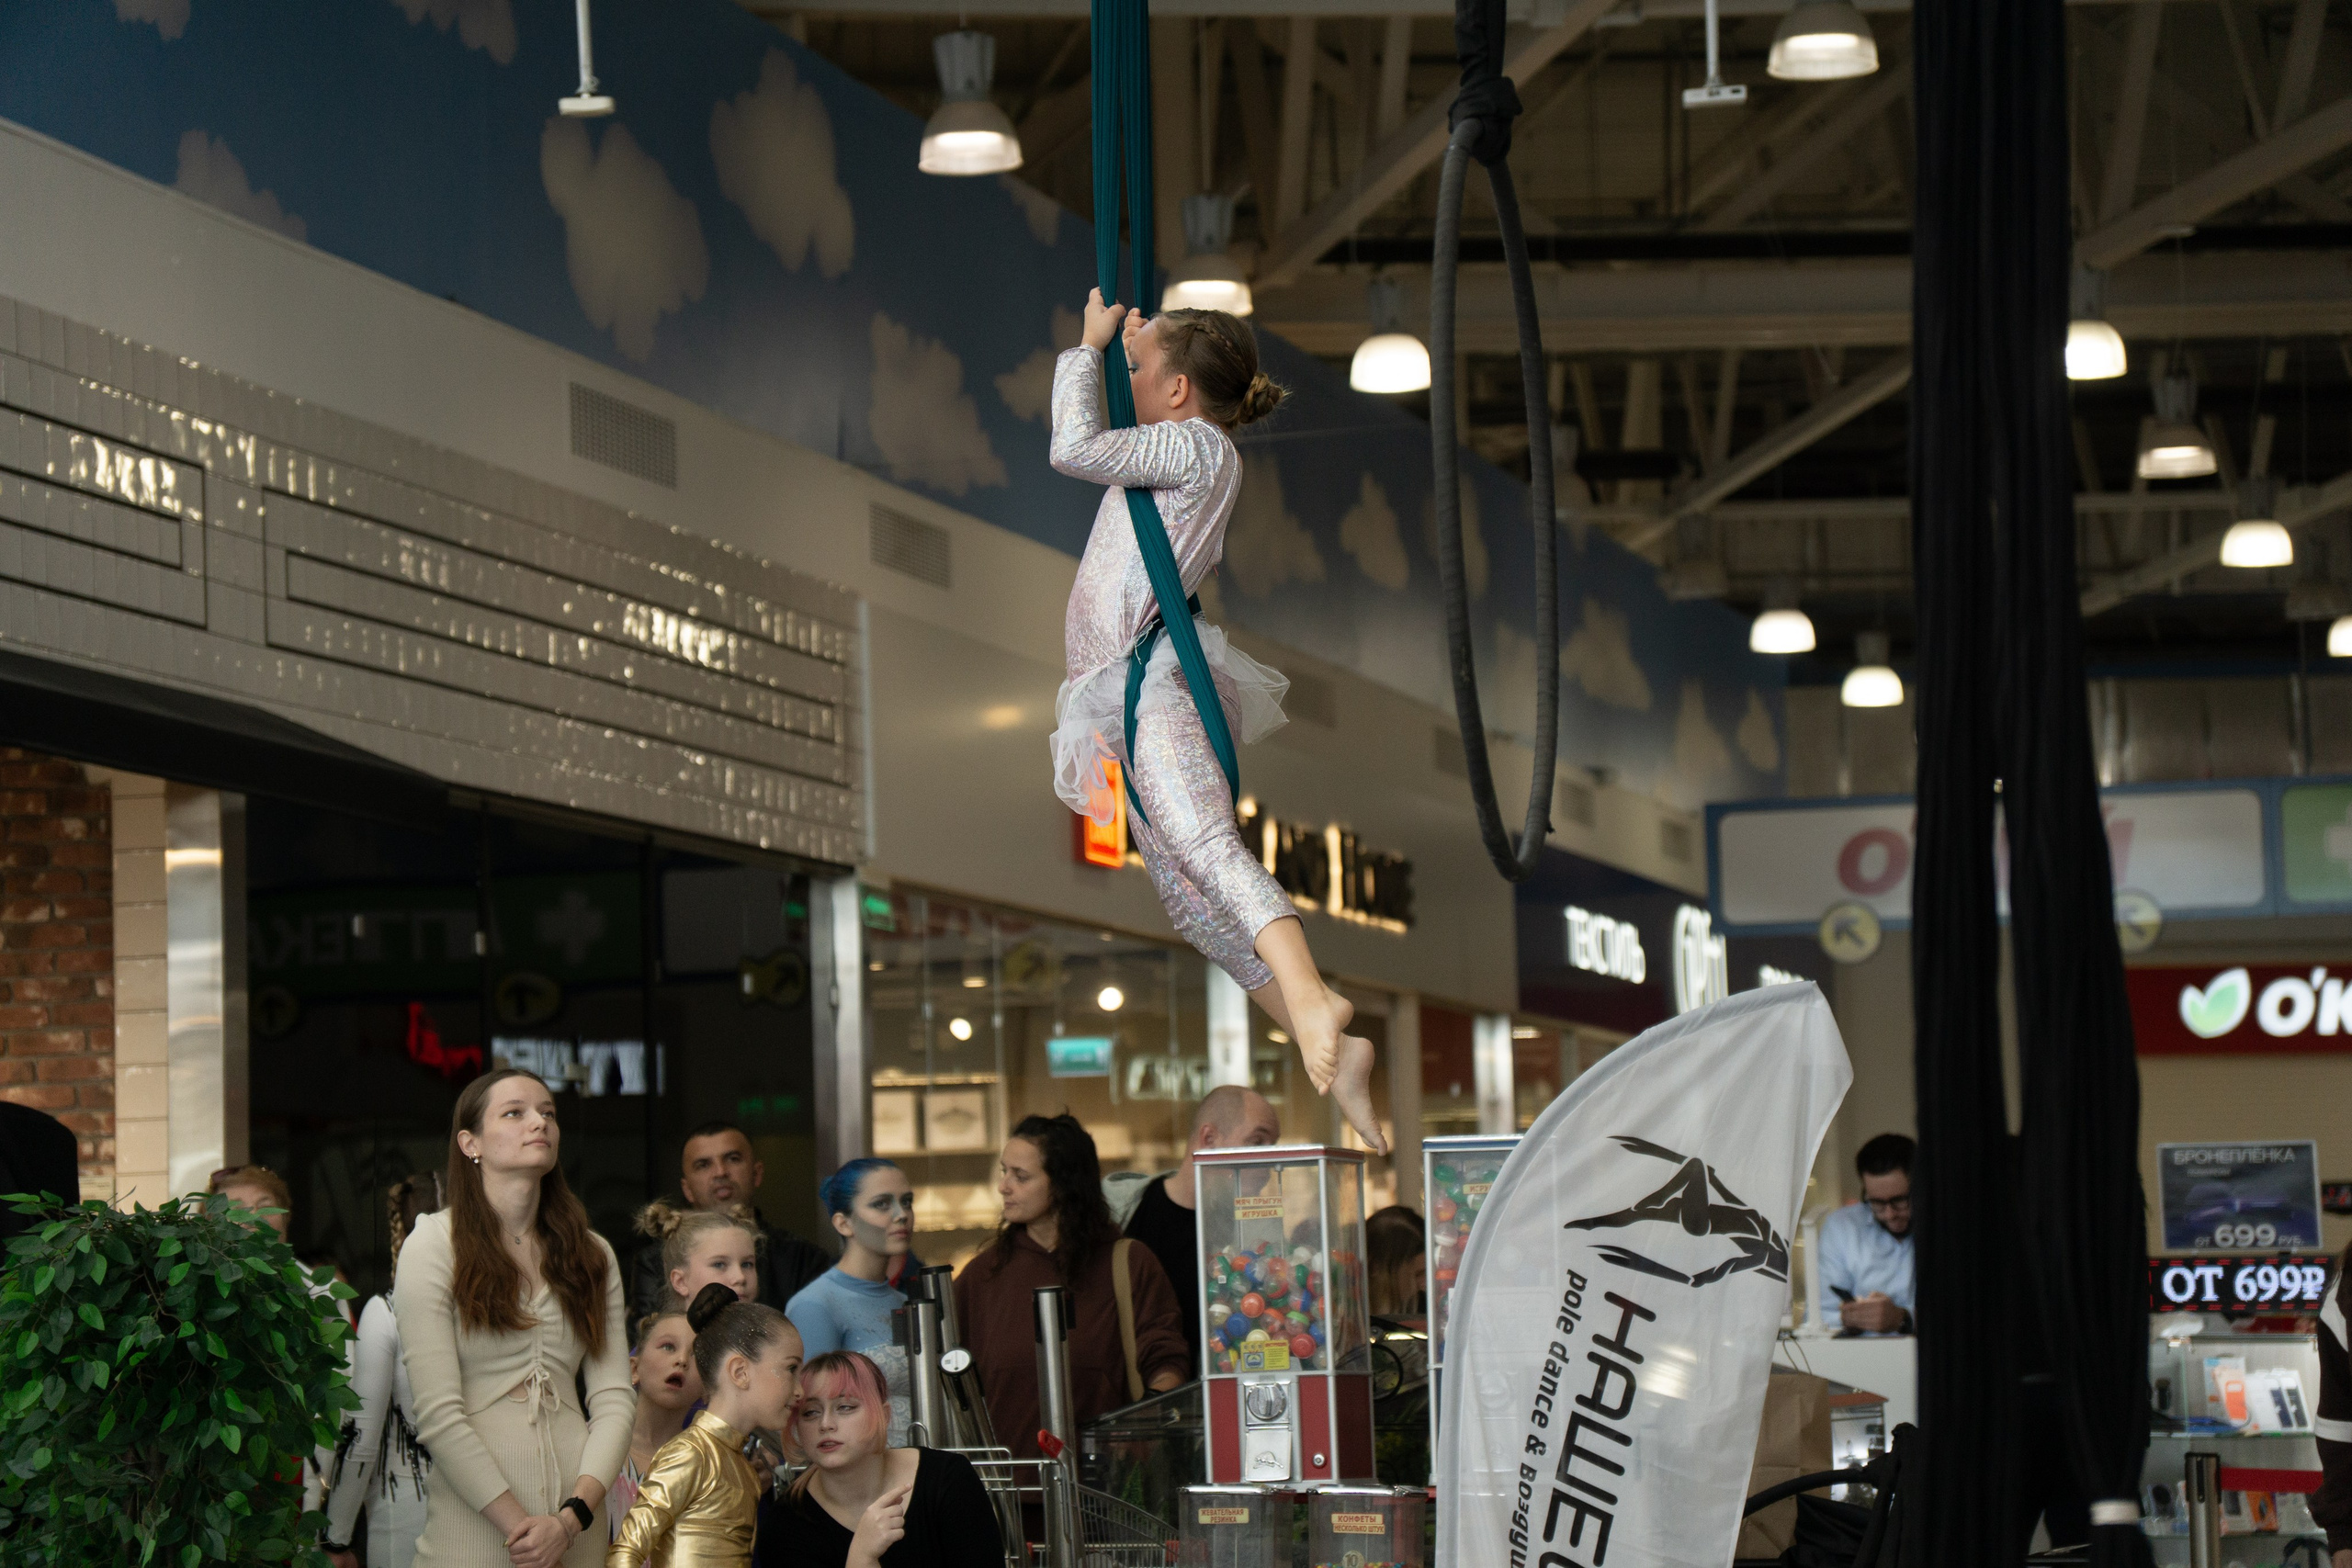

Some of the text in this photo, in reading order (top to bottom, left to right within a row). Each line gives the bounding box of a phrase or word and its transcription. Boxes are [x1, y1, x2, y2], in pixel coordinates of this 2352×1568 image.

[1242, 1209, 1278, 1218] ИГРУШКА
[2214, 1223, 2277, 1248] 699
[2162, 1264, 2326, 1303] ОТ 699₽
[1556, 1269, 1588, 1335] pole
[1531, 1341, 1569, 1429] dance
[1525, 1434, 1546, 1456] &
[1201, 1508, 1244, 1517] ЖЕВАТЕЛЬНАЯ
[1338, 1515, 1376, 1523] КОНФЕТЫ
[1334, 1524, 1385, 1533] НЕСКОЛЬКО ШТУК
